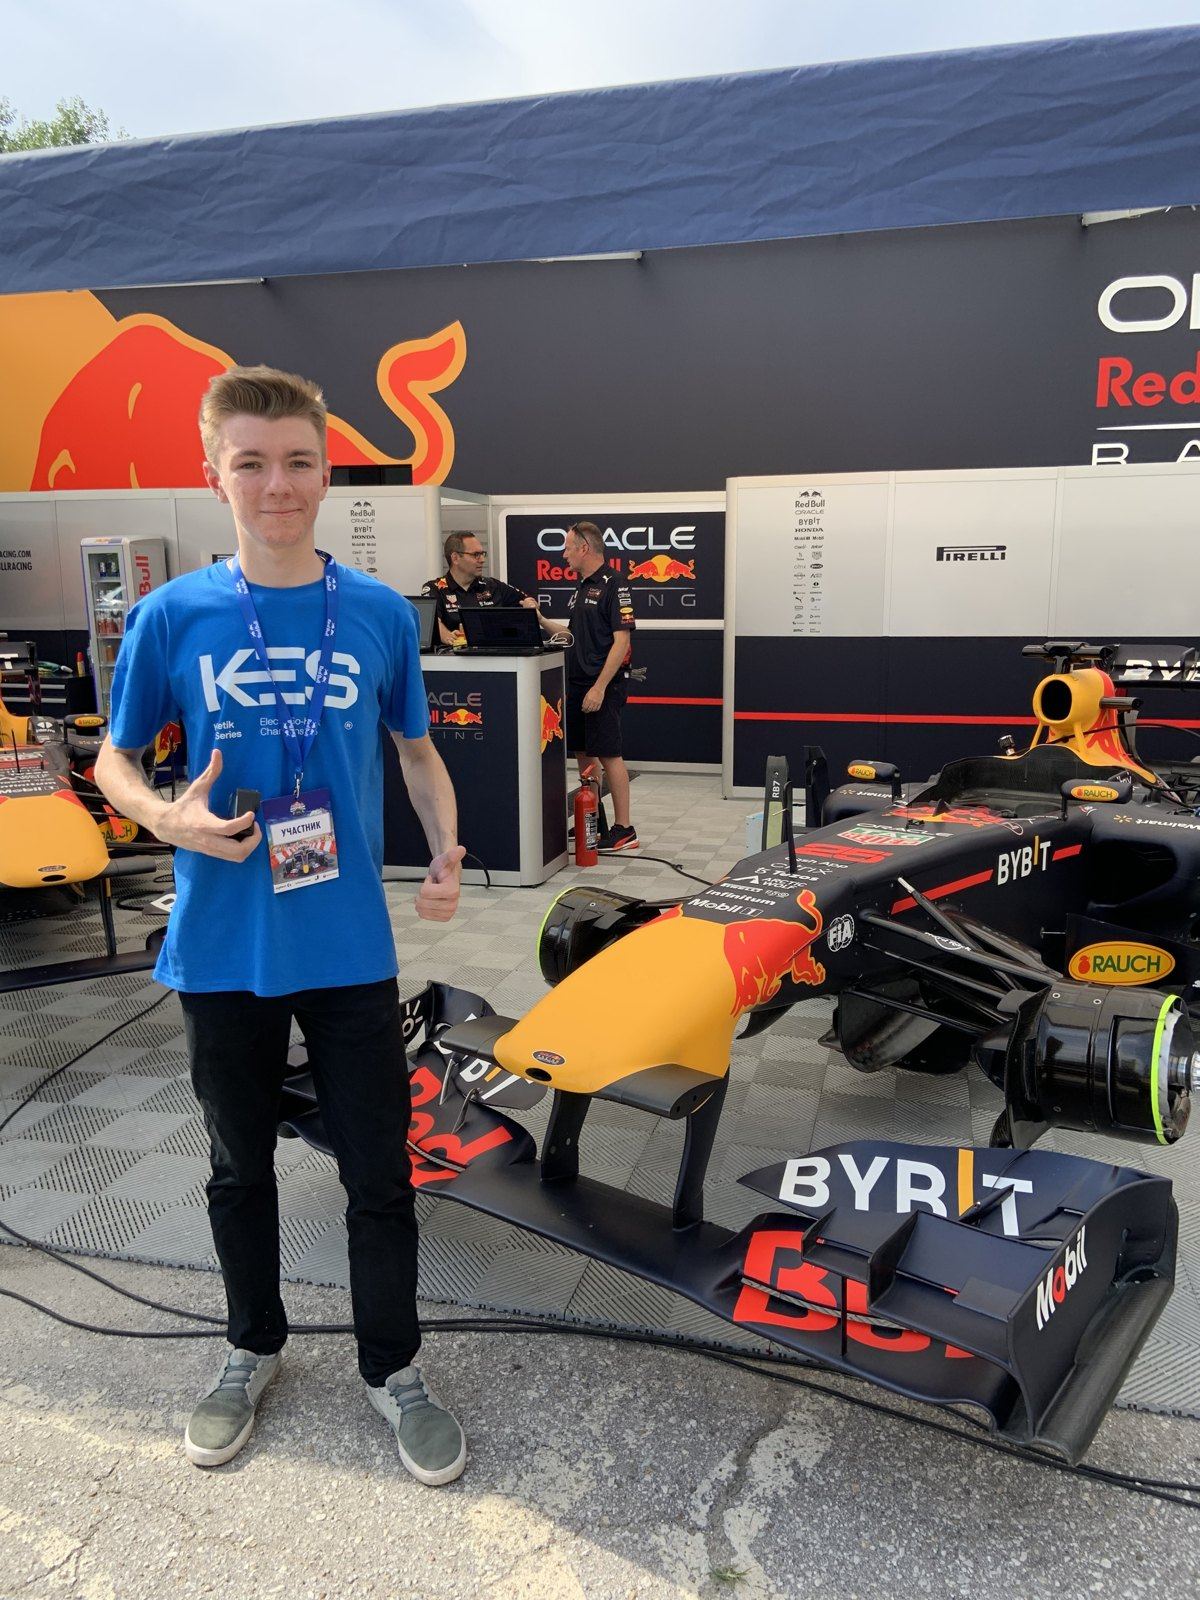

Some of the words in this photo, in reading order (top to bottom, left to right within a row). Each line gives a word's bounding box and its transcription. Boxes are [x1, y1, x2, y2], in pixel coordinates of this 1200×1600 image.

[536, 526, 697, 551] OACLE
[936, 545, 1007, 562] PIRELLI
[199, 647, 361, 713] KES
[214, 730, 243, 741] Series
[855, 768, 874, 776] RAUCH
[771, 780, 781, 798] RB7
[1083, 790, 1113, 799] RAUCH
[281, 821, 321, 837] УЧАСТНИК
[857, 822, 954, 837] ORACLE
[997, 835, 1051, 885] BYBIT
[687, 898, 741, 914] Mobil
[1092, 954, 1162, 973] RAUCH
[1036, 1224, 1088, 1331] Mobil
